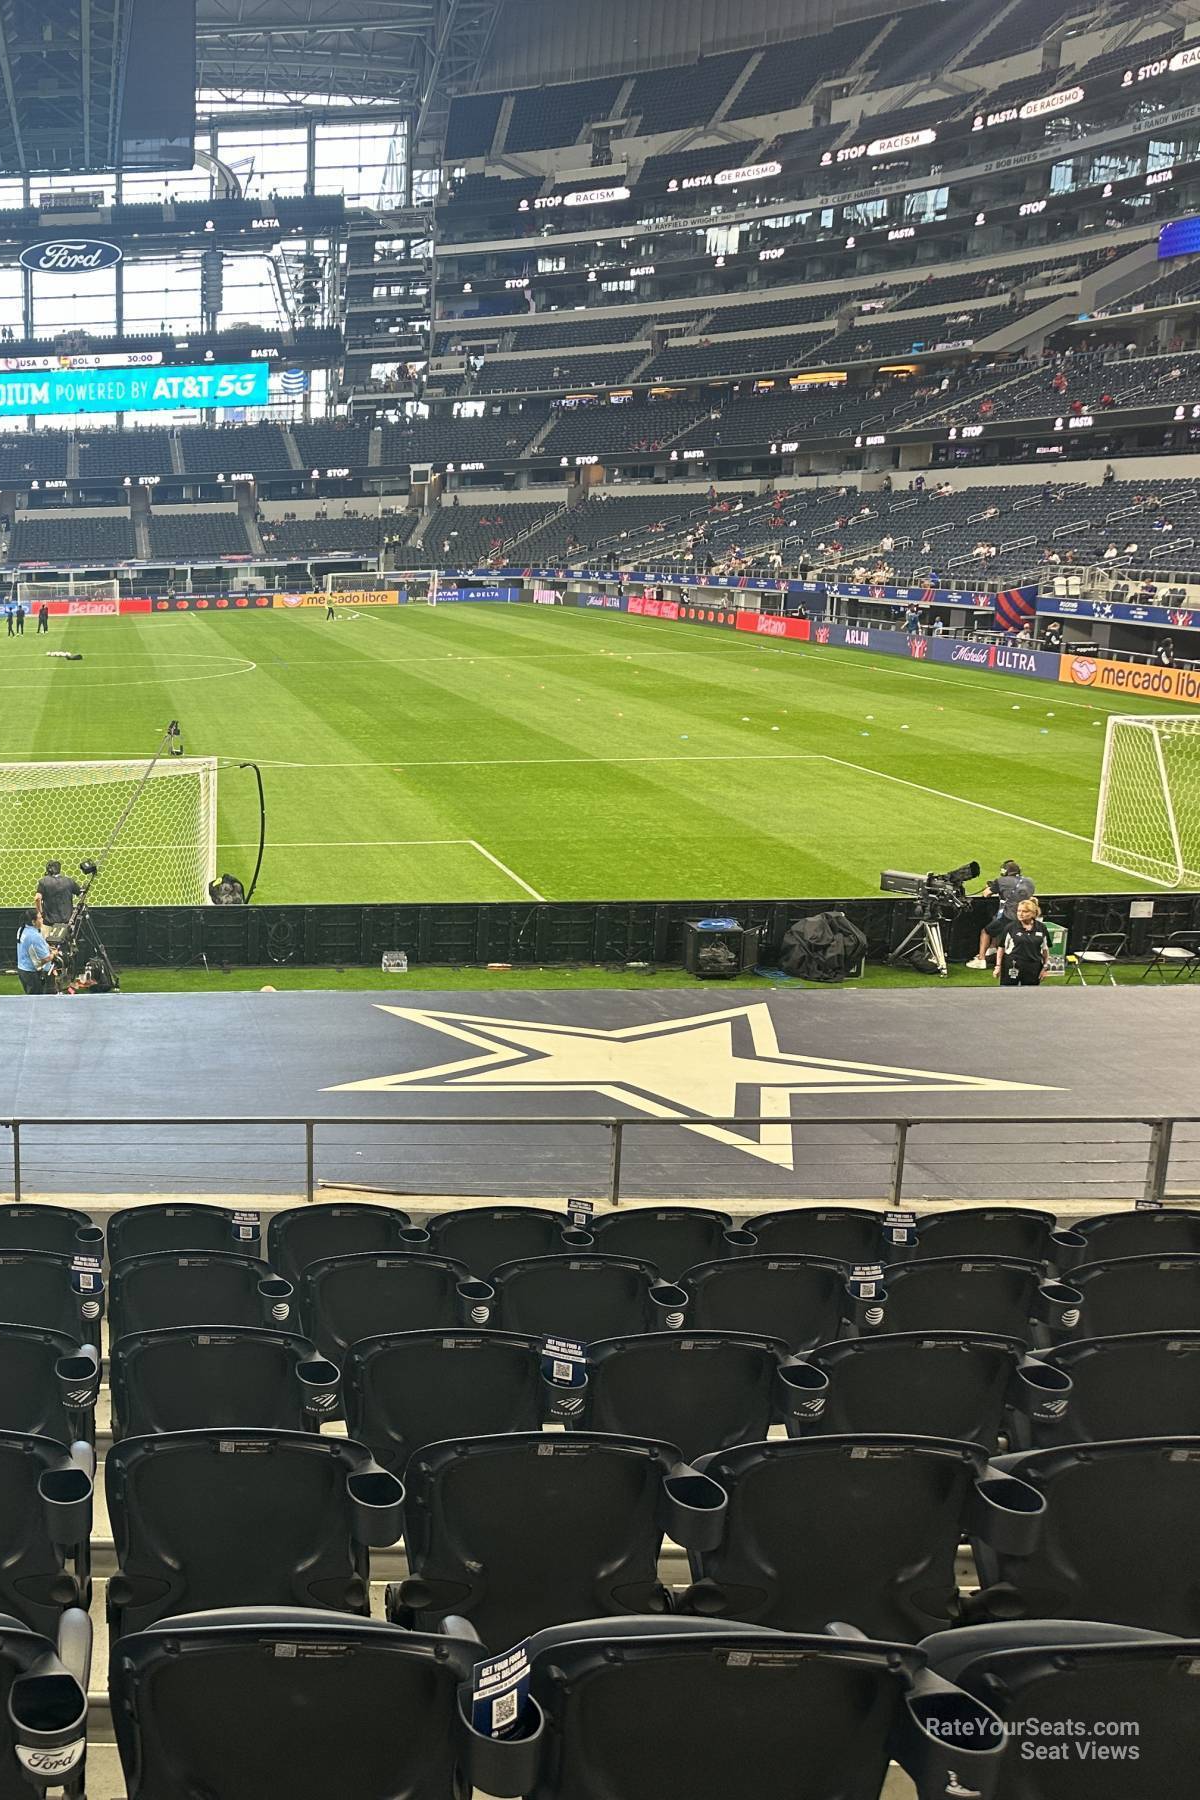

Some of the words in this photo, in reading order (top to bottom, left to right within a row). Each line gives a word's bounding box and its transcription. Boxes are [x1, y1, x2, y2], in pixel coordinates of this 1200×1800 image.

[1138, 60, 1167, 80] STOP
[987, 109, 1017, 126] BASTA
[1026, 104, 1038, 114] DE
[1040, 90, 1078, 111] RACISMO
[1145, 116, 1168, 129] RANDY
[1169, 108, 1195, 122] WHITE
[837, 145, 865, 161] STOP
[879, 133, 920, 151] RACISM
[1014, 153, 1038, 166] HAYES
[683, 175, 712, 188] BASTA
[720, 172, 733, 182] DE
[735, 164, 776, 179] RACISMO
[1146, 167, 1172, 185] BASTA
[534, 196, 562, 208] STOP
[575, 189, 615, 203] RACISM
[832, 192, 851, 203] CLIFF
[854, 188, 880, 200] HARRIS
[1020, 201, 1046, 215] STOP
[252, 219, 279, 228] BASTA
[655, 219, 688, 230] RAYFIELD
[691, 215, 719, 226] WRIGHT
[888, 228, 914, 240] BASTA
[39, 243, 101, 269] Ford
[759, 248, 784, 260] STOP
[630, 266, 654, 276] BASTA
[505, 279, 529, 288] STOP
[127, 354, 153, 363] 30:00
[251, 349, 278, 357] BASTA
[20, 359, 37, 367] USA
[72, 356, 89, 365] BOL
[55, 382, 126, 401] POWERED
[131, 381, 148, 399] BY
[152, 375, 214, 400] AT&T
[215, 373, 257, 397] 5G
[1069, 416, 1093, 428] BASTA
[962, 426, 983, 437] STOP
[782, 443, 798, 452] STOP
[576, 456, 598, 465] STOP
[327, 469, 349, 477] STOP
[307, 594, 360, 605] mecado
[362, 592, 388, 602] libre
[69, 603, 114, 614] Betano
[758, 616, 786, 636] Betano
[997, 653, 1037, 671] ULTRA
[1101, 666, 1173, 693] mercado
[481, 1665, 493, 1677] GET
[27, 1749, 75, 1773] Ford
